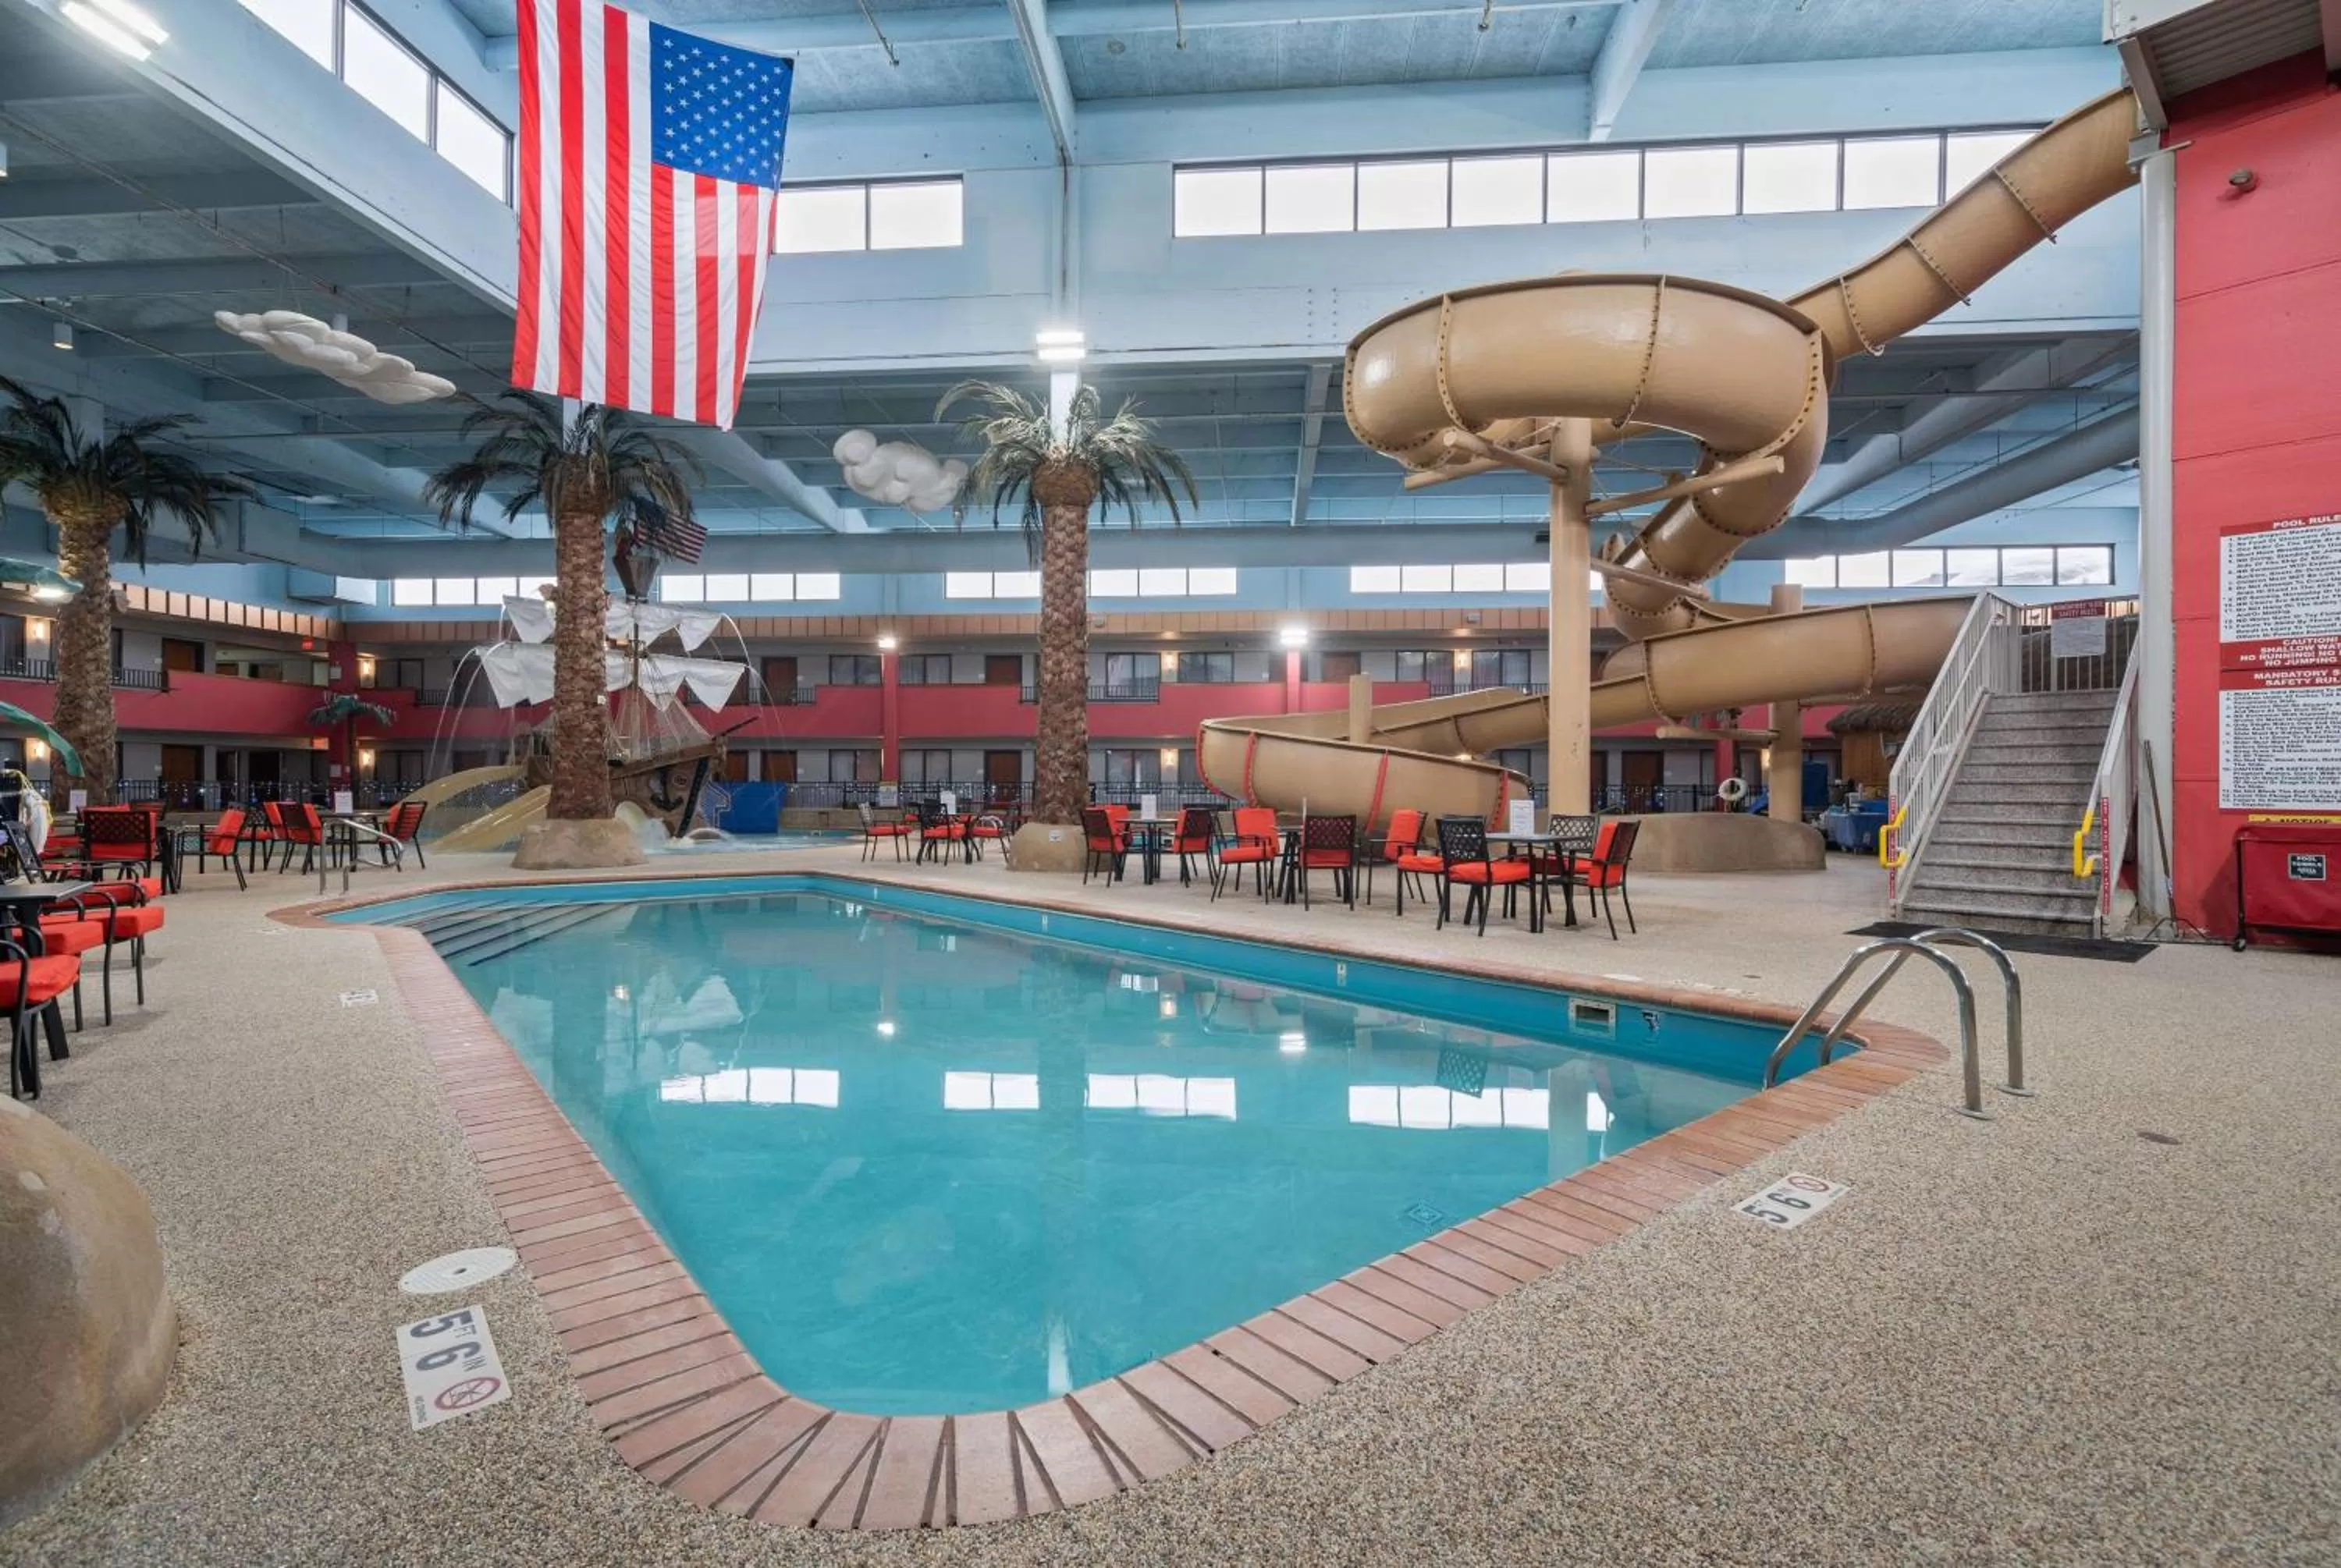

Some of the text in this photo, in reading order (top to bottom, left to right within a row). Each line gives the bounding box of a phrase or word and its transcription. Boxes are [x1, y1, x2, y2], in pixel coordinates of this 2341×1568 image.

[2272, 519, 2305, 529] POOL
[2282, 636, 2339, 646] CAUTION!
[2260, 644, 2315, 653] SHALLOW
[2240, 654, 2256, 662] NO
[2259, 651, 2315, 661] RUNNING!
[2284, 656, 2338, 665] JUMPING
[2254, 670, 2328, 679] MANDATORY
[2265, 678, 2312, 686] SAFETY
[1741, 1204, 1790, 1224] 5
[1767, 1191, 1812, 1210] 6
[410, 1310, 474, 1338] 5
[415, 1341, 482, 1372] 6
